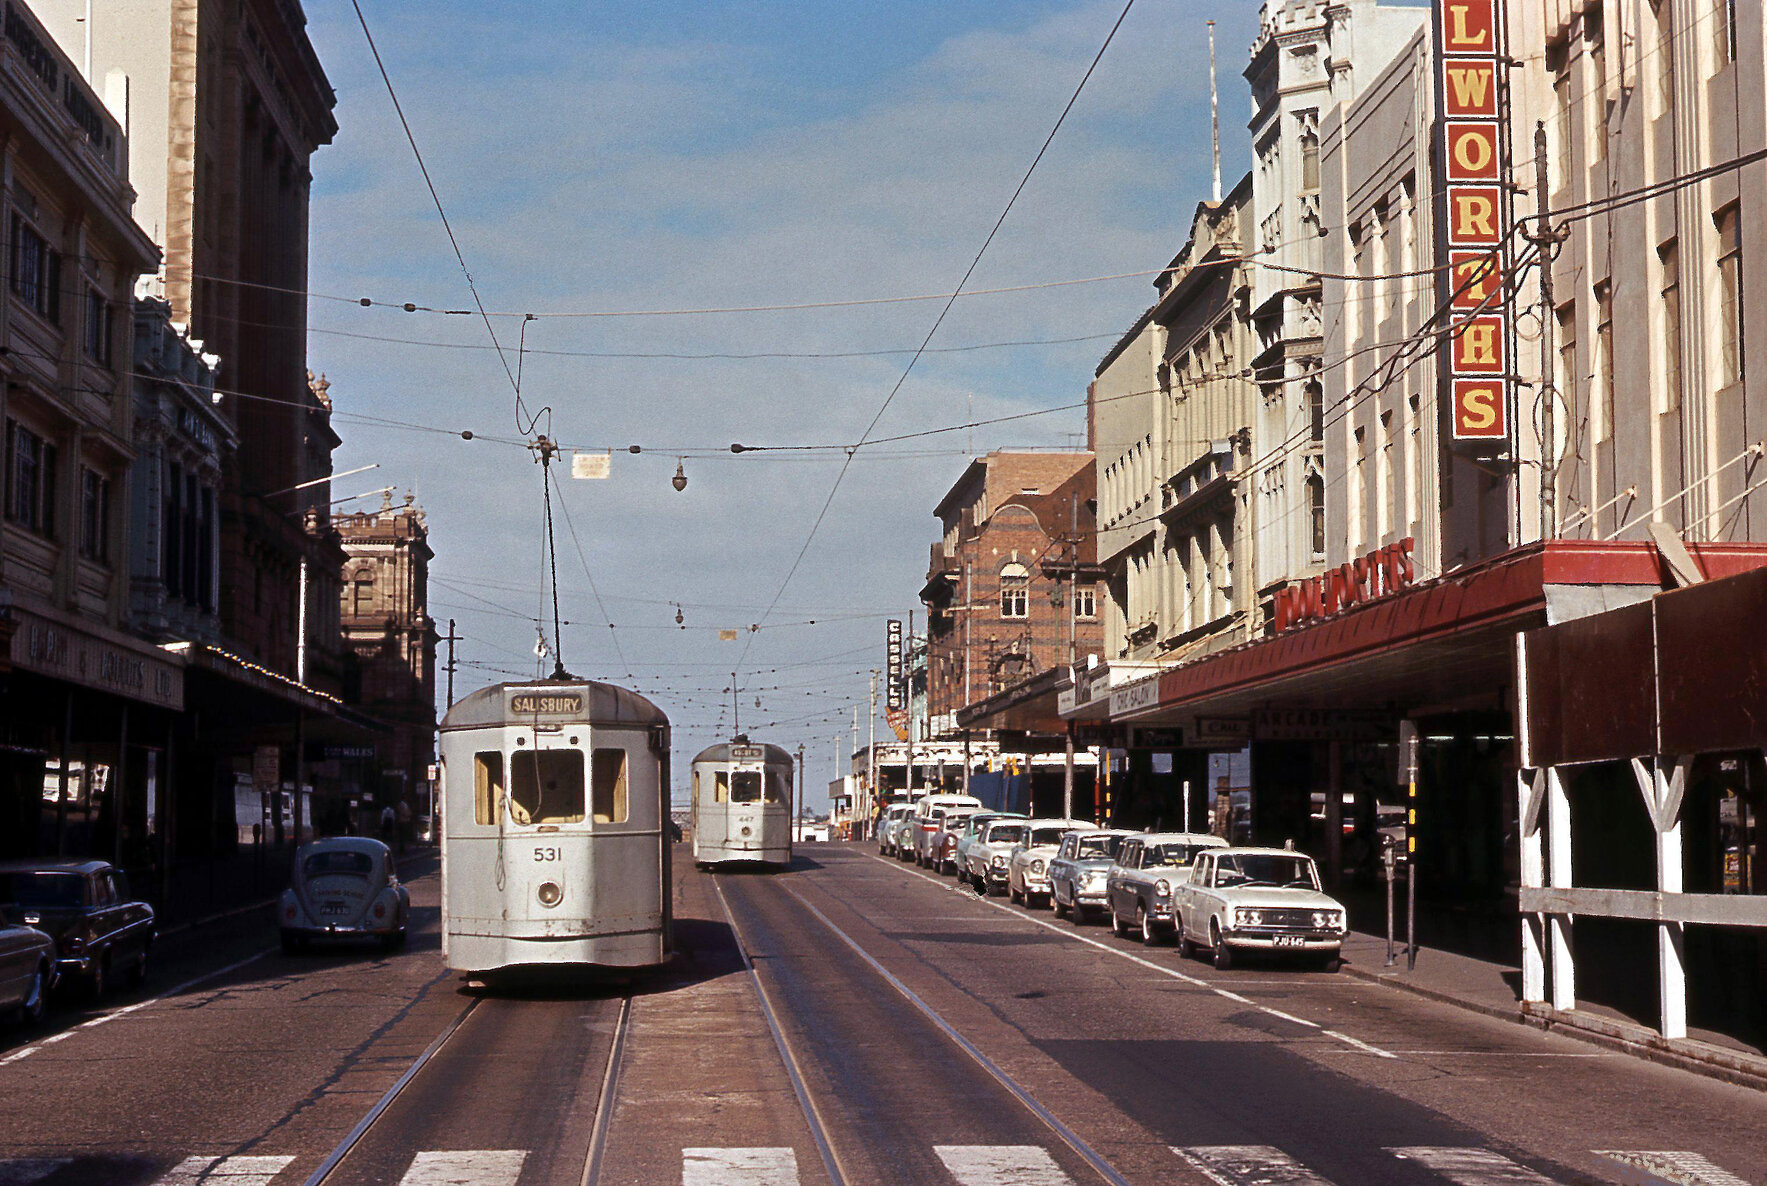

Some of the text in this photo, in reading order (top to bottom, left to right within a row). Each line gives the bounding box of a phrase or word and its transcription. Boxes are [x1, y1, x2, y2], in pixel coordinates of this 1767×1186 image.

[1448, 4, 1498, 429] LWORTHS
[889, 622, 900, 707] CASSELLS
[514, 697, 580, 712] SALISBURY
[343, 747, 374, 757] WALES
[533, 847, 562, 863] 531
